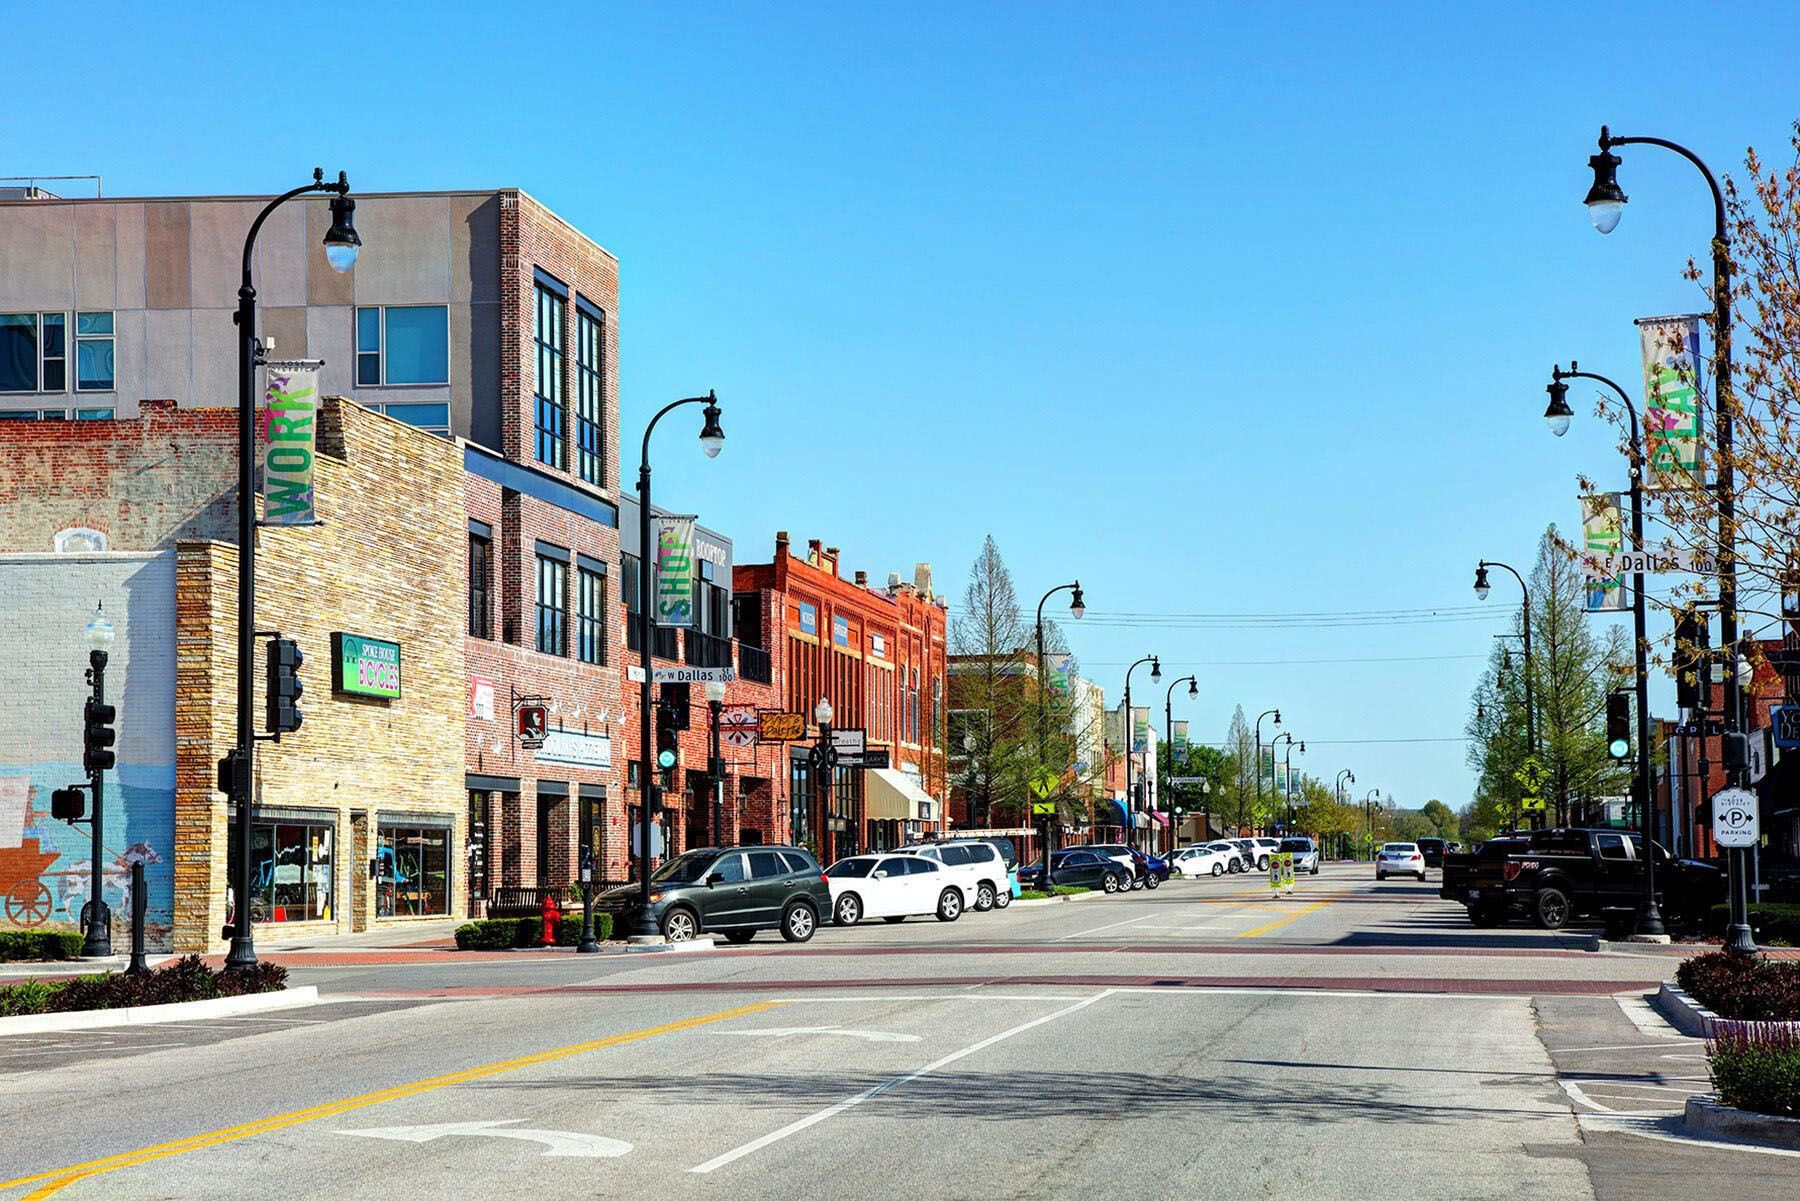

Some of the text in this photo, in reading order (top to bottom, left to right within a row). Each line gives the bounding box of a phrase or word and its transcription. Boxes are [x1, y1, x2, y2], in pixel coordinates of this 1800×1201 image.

[1647, 364, 1699, 471] PLAY
[266, 386, 316, 518] WORK
[1605, 557, 1612, 569] E
[1621, 554, 1680, 572] Dallas
[1690, 560, 1713, 572] 100
[659, 531, 691, 616] SHOP
[362, 643, 396, 662] SPOKE HOUSE
[358, 658, 400, 691] BICYCLES
[667, 667, 730, 682] W Dallas St
[719, 674, 733, 682] 100
